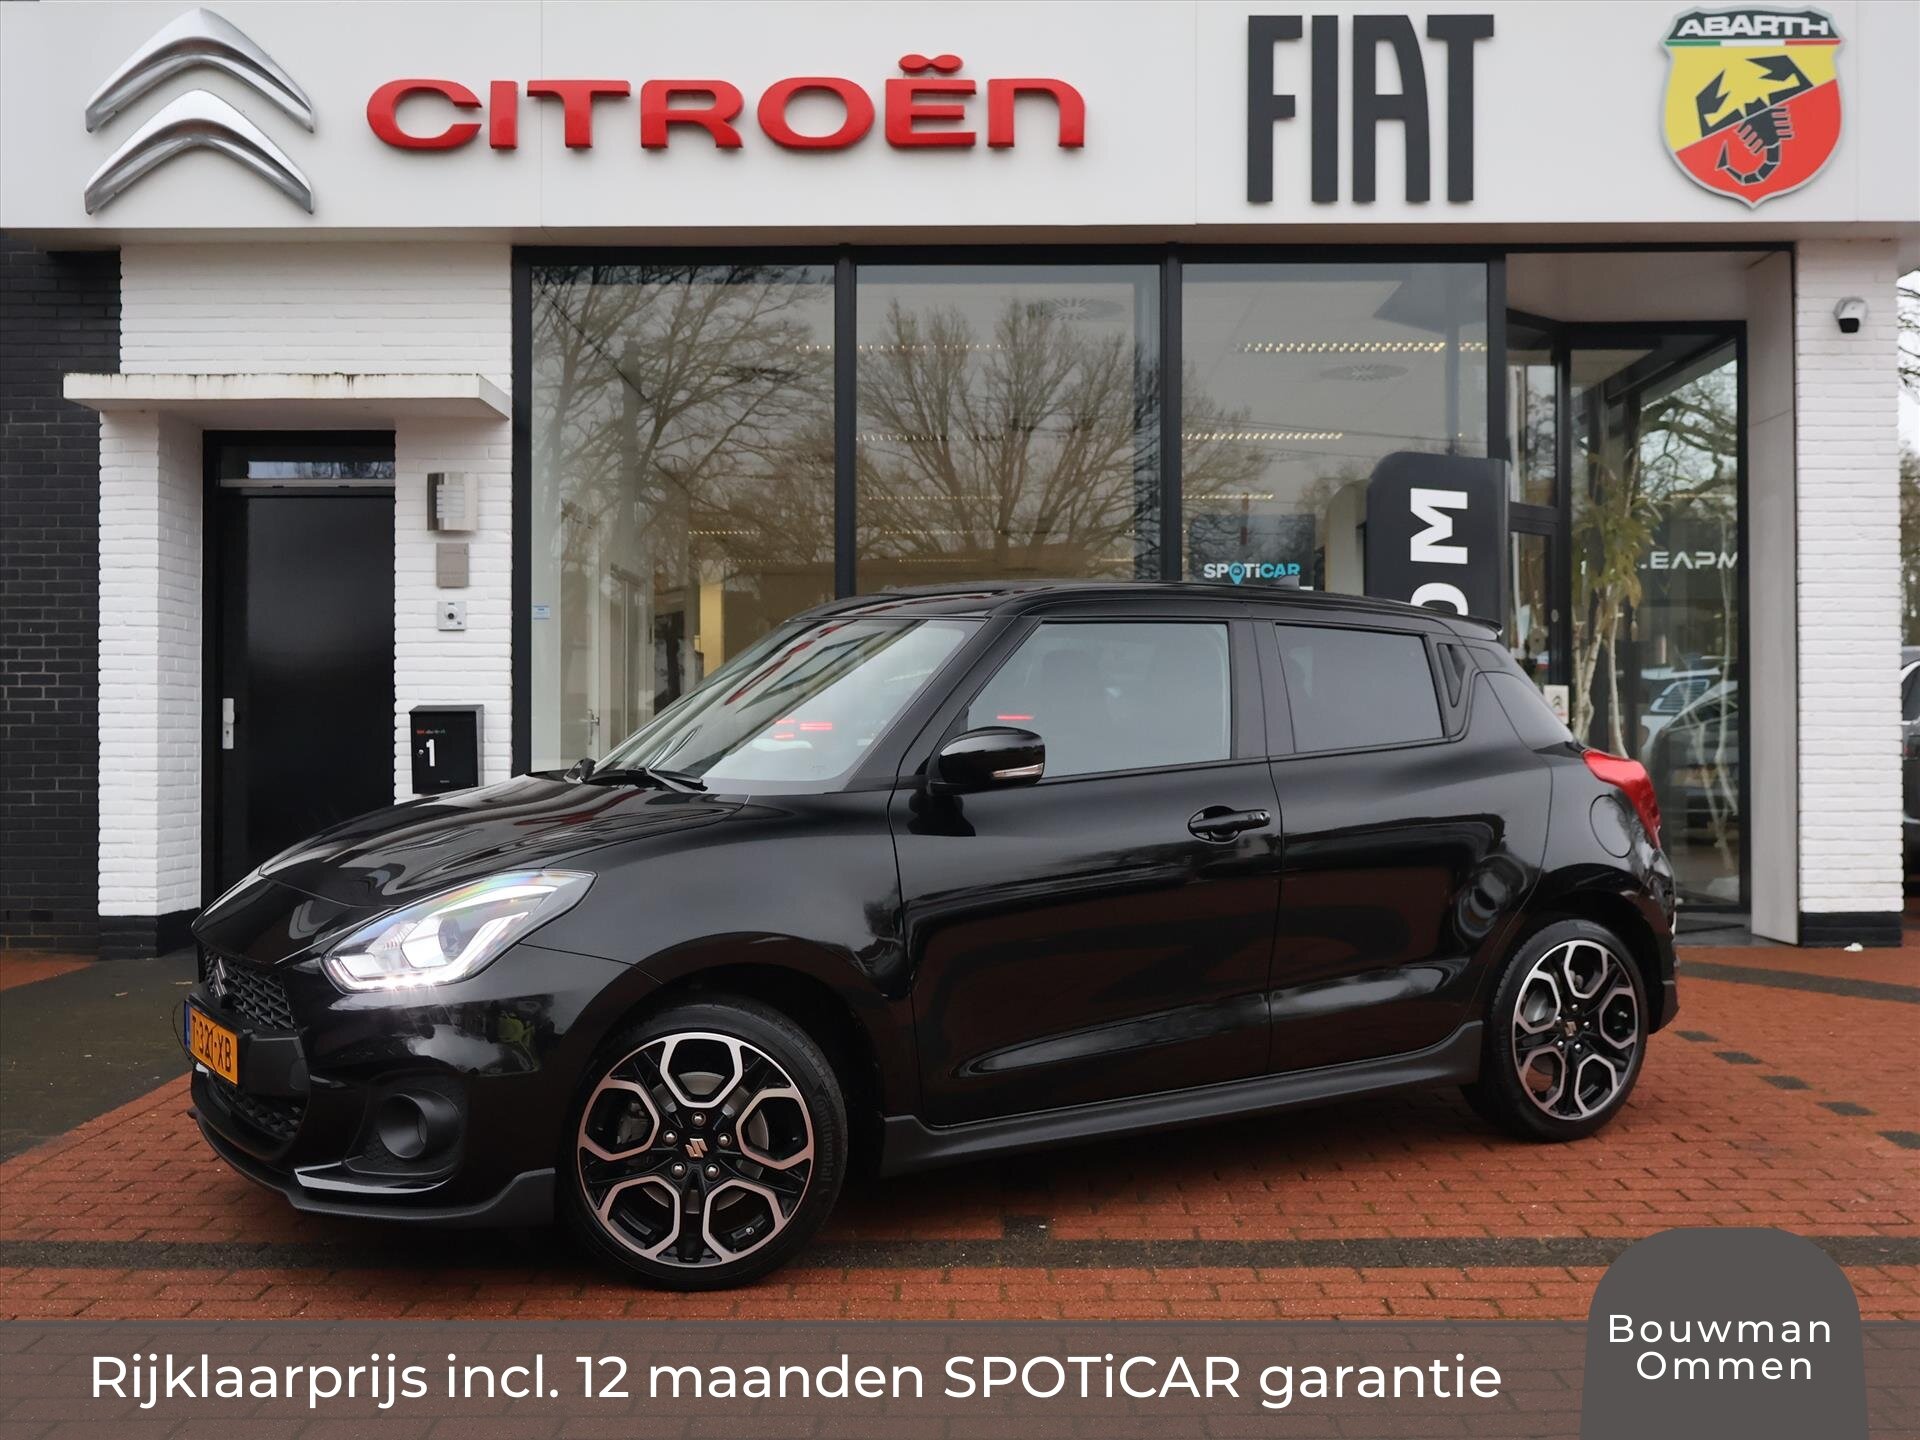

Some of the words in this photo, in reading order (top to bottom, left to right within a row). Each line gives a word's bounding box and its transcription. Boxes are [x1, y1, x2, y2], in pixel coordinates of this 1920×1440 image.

[1677, 14, 1829, 37] ABARTH
[367, 54, 1086, 150] CITROËN
[1247, 14, 1494, 204] FIAT
[1640, 550, 1738, 570] EAPM
[426, 738, 436, 768] 1
